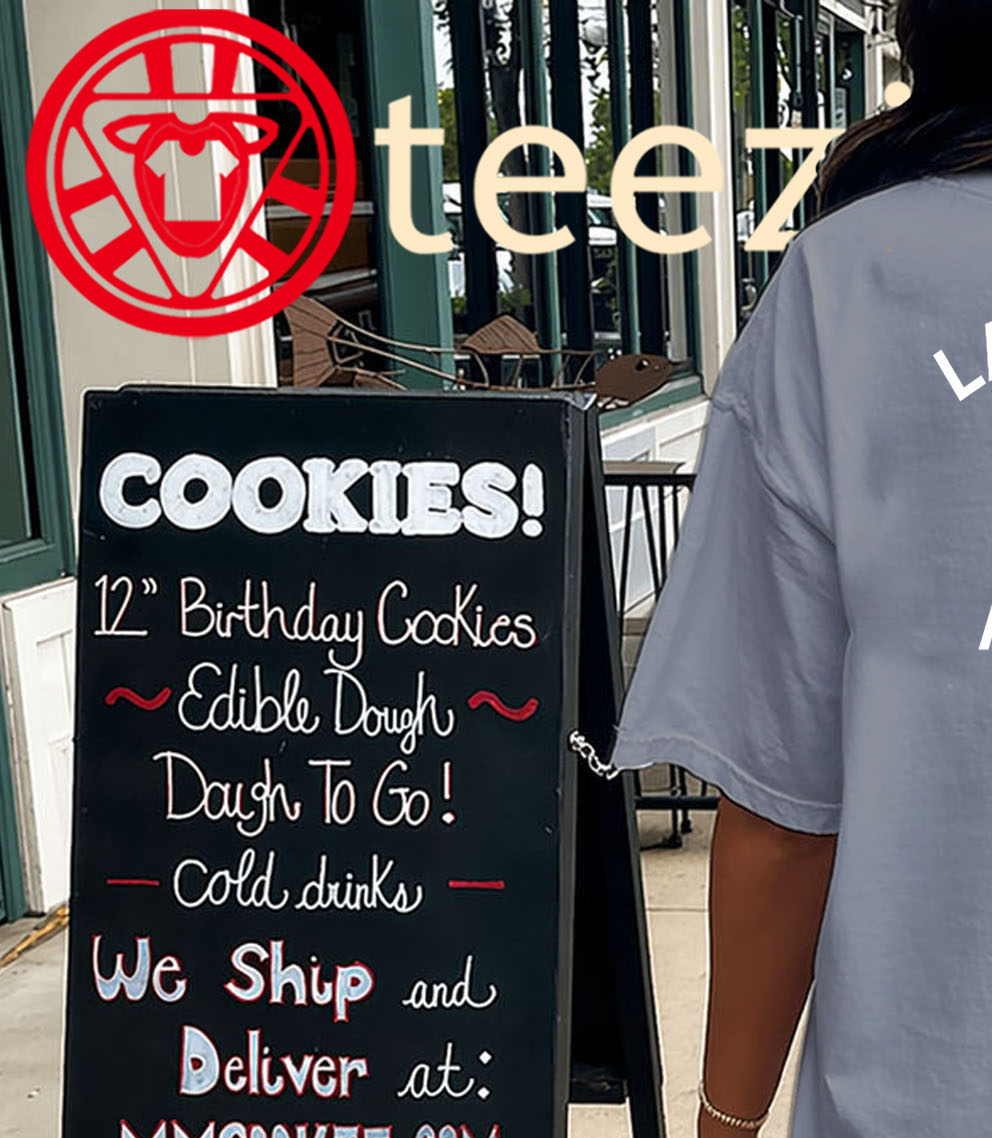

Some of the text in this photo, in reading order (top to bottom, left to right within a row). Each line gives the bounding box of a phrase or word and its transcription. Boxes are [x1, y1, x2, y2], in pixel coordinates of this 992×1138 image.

[98, 452, 546, 540] COOKIES!
[180, 577, 364, 670] Birthday
[178, 661, 455, 755] Edible Dough
[152, 750, 301, 838] Dough
[308, 759, 356, 824] To
[92, 934, 497, 1023] We Ship and
[178, 1025, 493, 1100] Deliver at:
